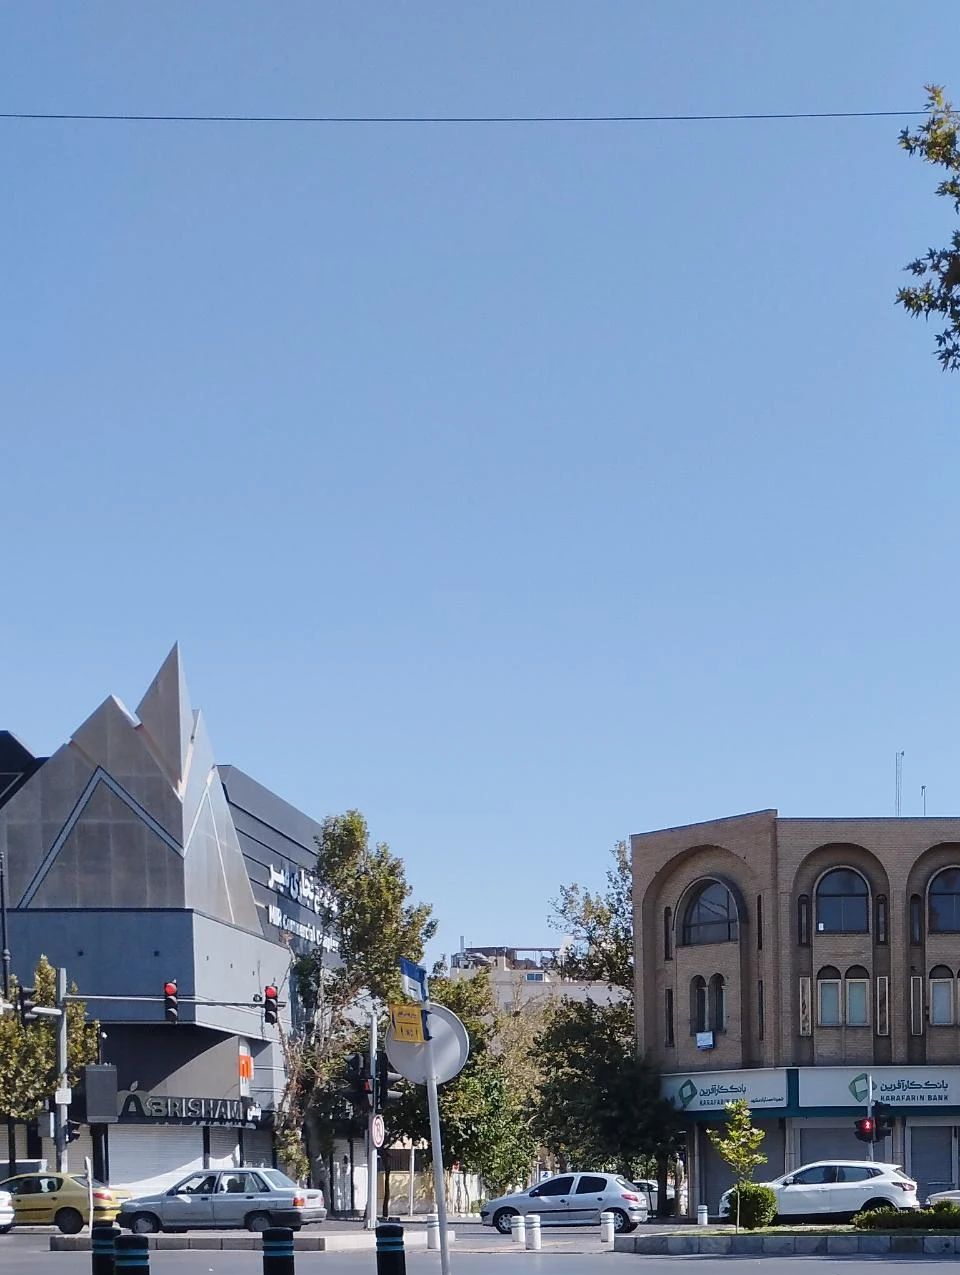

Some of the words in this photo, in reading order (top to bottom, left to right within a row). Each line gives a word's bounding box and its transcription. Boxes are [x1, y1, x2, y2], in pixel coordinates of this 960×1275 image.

[268, 904, 283, 929] MIR
[699, 1084, 728, 1097] کارآفرین
[728, 1083, 747, 1095] بانک
[880, 1079, 922, 1092] کارآفرین
[923, 1079, 949, 1092] بانک
[880, 1094, 925, 1102] KARAFARIN
[927, 1094, 949, 1102] BANK
